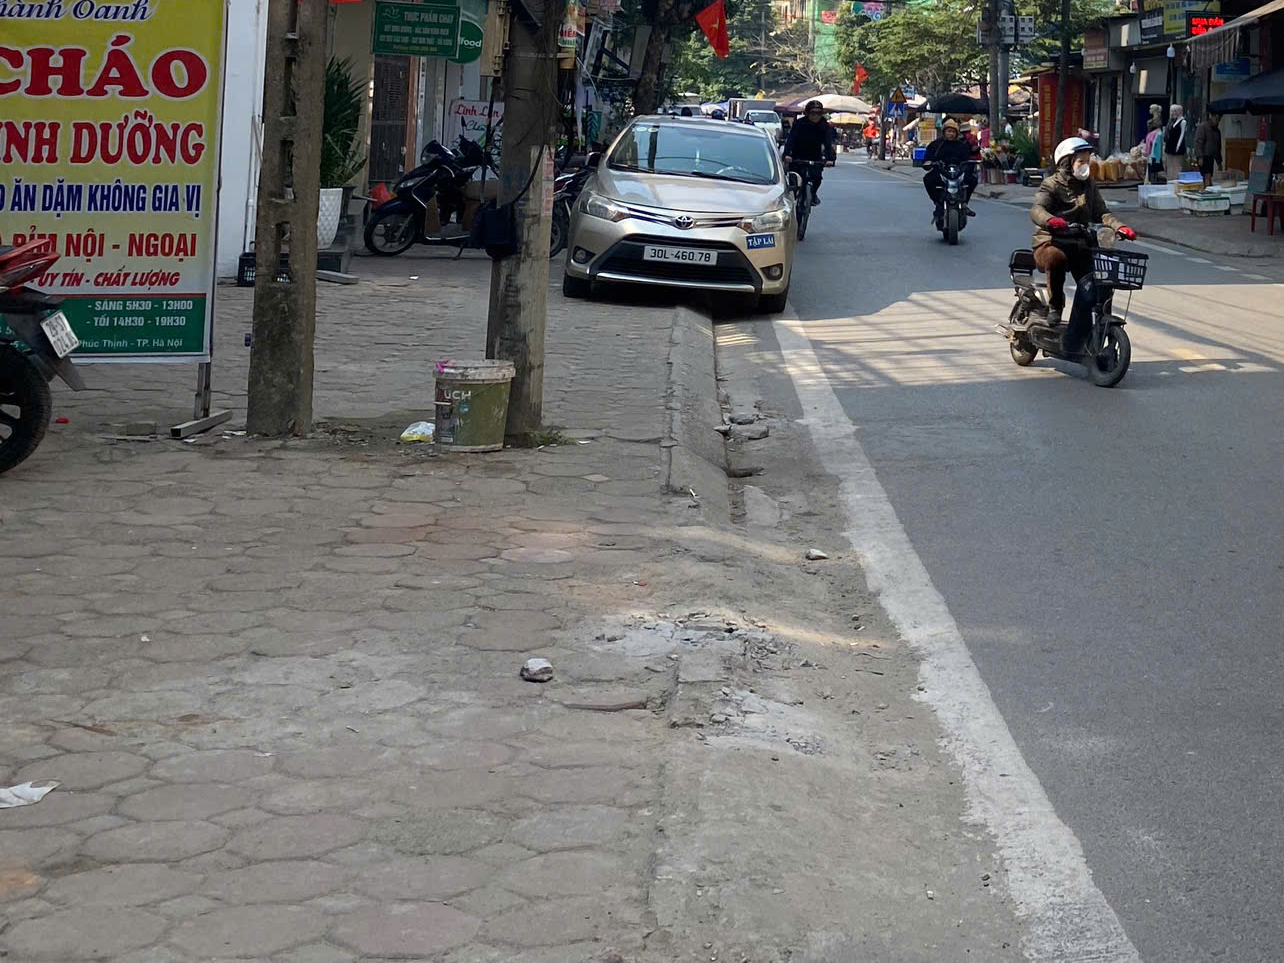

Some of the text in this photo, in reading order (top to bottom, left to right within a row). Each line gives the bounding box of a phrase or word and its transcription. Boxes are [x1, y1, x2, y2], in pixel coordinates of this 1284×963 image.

[0, 35, 207, 98] CHÁO
[480, 105, 500, 117] Ln
[0, 110, 205, 165] NH DƯỠNG
[10, 179, 36, 212] ĂN
[41, 178, 82, 218] DẶM
[88, 179, 147, 212] KHÔNG
[152, 184, 180, 212] GIA
[185, 184, 201, 218] VỊ
[65, 228, 105, 263] NỘI
[128, 233, 197, 263] NGOẠI
[650, 249, 711, 262] 30L-460.78
[61, 268, 84, 287] TÍN
[93, 266, 131, 287] CHẤT
[131, 269, 181, 290] LƯỢNG
[95, 298, 193, 311] SÁNG 5H30 13H00
[94, 313, 186, 326] TỐI 14H30 19H30
[152, 338, 165, 348] Hà
[167, 337, 183, 348] Nội
